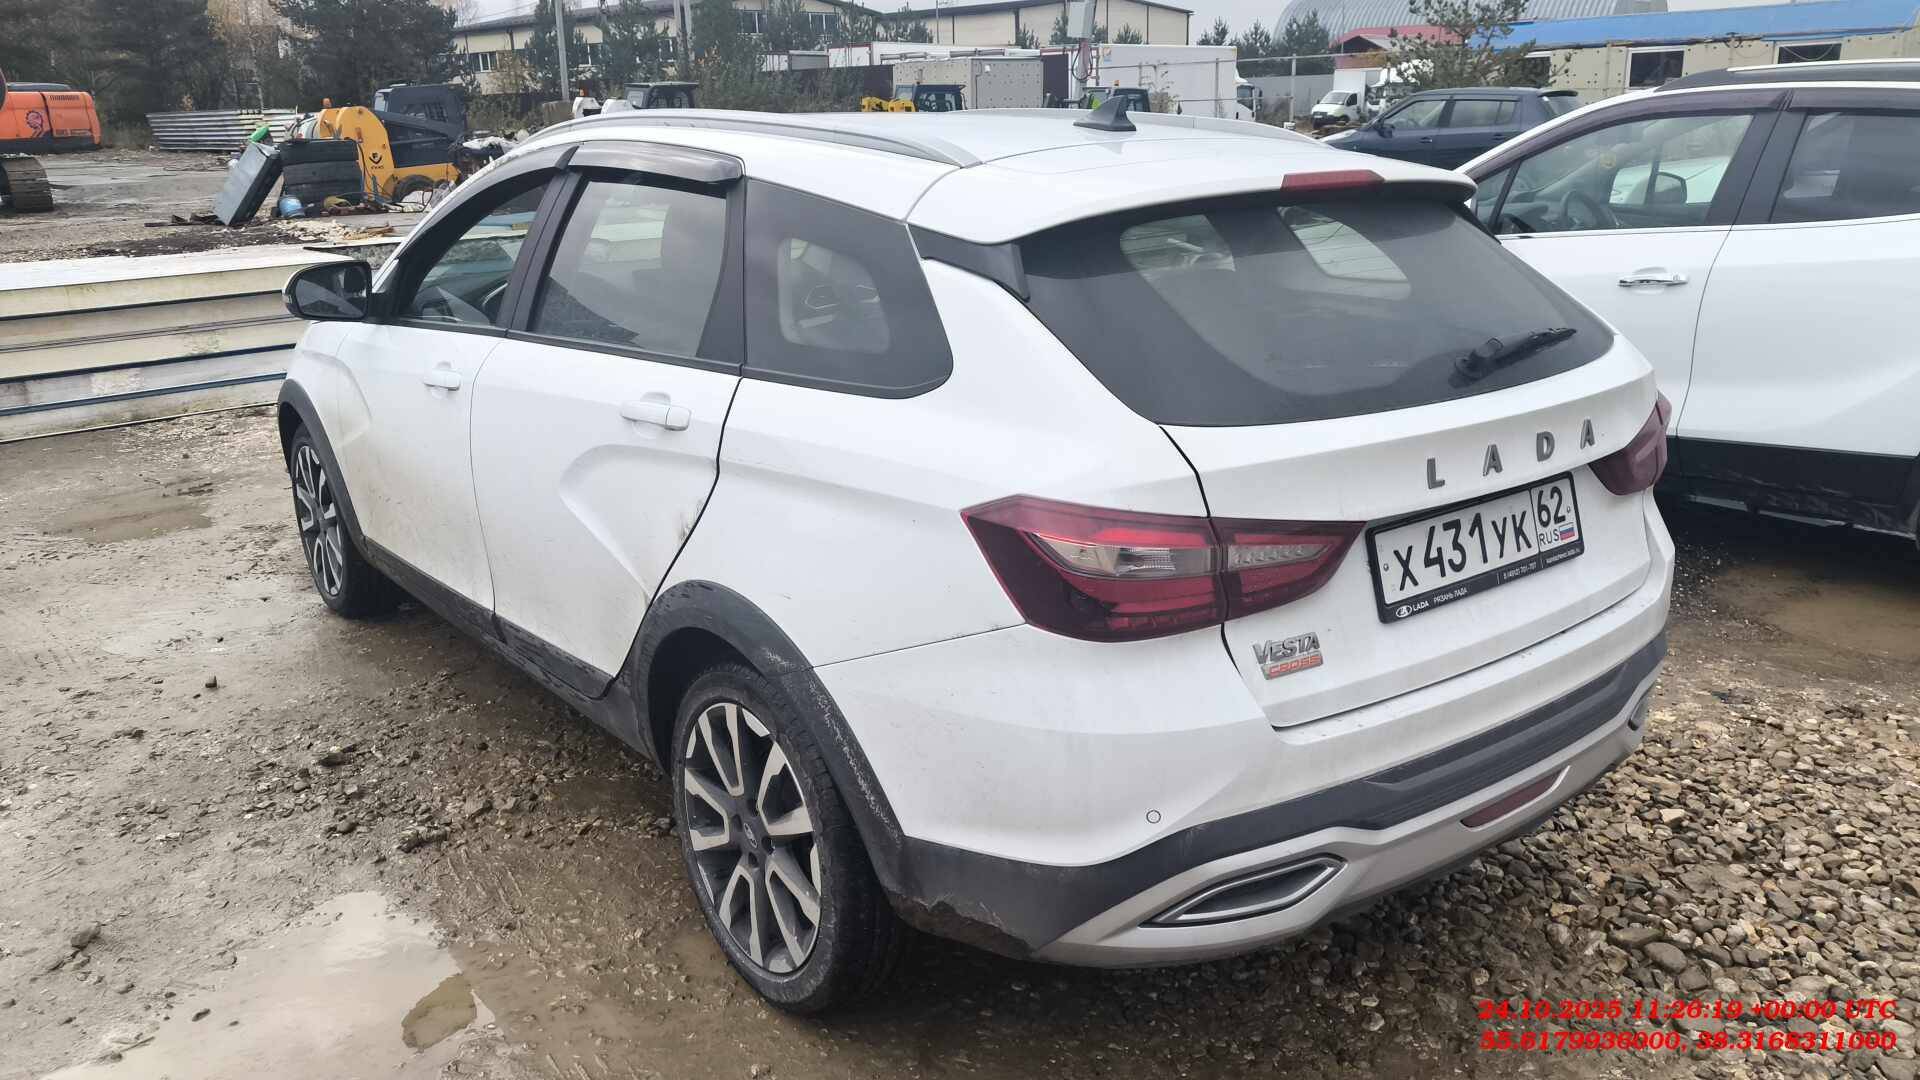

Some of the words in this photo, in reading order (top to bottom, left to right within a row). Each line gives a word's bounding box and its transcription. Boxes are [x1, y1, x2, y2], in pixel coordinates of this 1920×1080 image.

[1426, 418, 1595, 490] LADA
[1393, 510, 1532, 591] Х431УК
[1537, 486, 1566, 528] 62
[1539, 528, 1560, 545] RUS
[1413, 600, 1429, 611] LADA
[1252, 631, 1320, 664] VESTA
